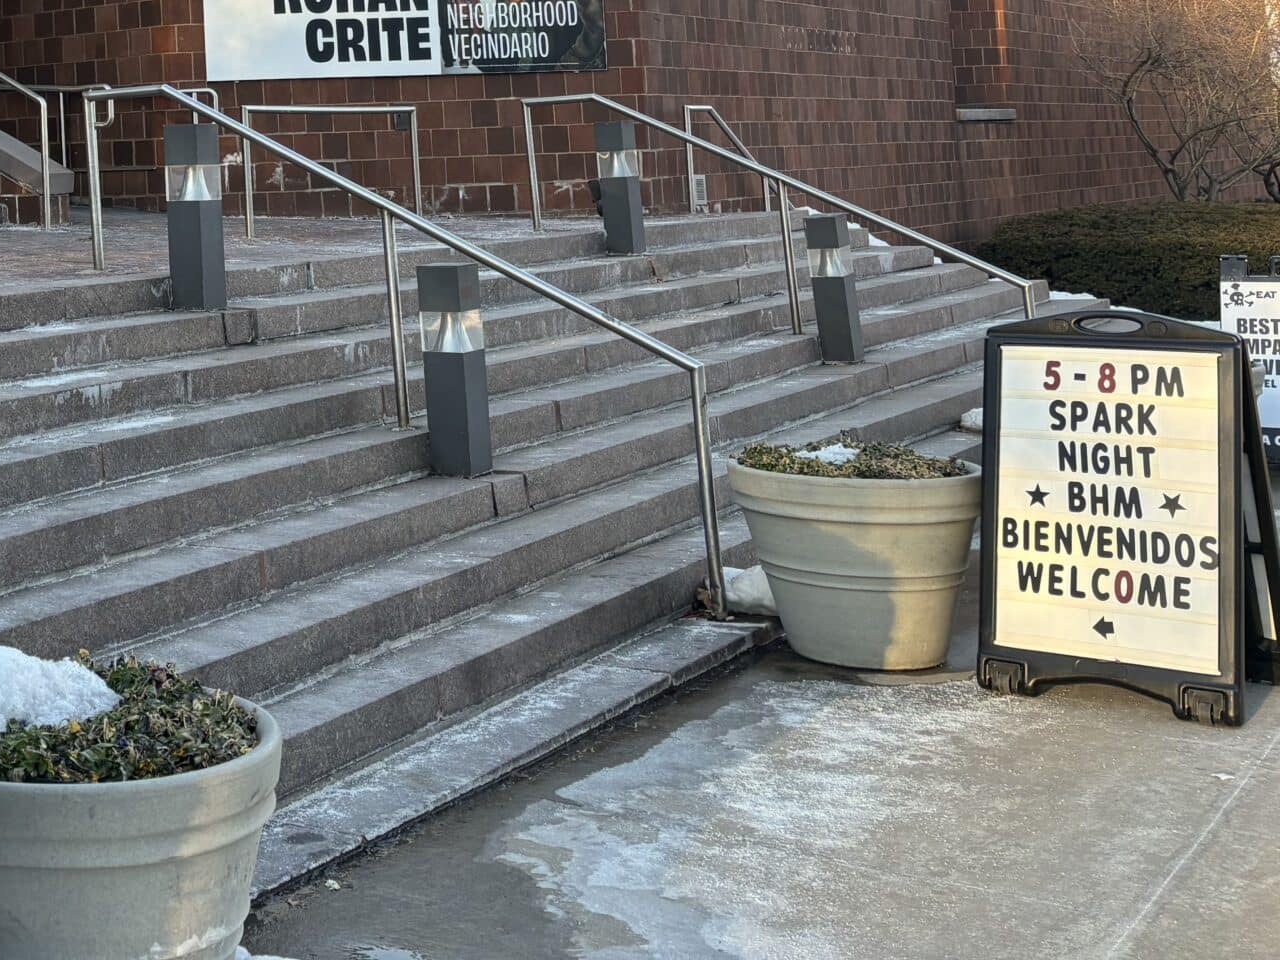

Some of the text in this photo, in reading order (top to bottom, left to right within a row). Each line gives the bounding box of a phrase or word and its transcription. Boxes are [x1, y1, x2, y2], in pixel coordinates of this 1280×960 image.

[446, 0, 579, 29] NEIGHBORHOOD
[305, 16, 433, 63] CRITE
[448, 31, 550, 60] VECINDARIO
[1255, 290, 1278, 299] EAT
[1236, 317, 1280, 335] BEST
[1130, 363, 1185, 397] PM
[1048, 399, 1157, 436] SPARK
[1057, 440, 1156, 478] NIGHT
[1067, 481, 1143, 519] BHM
[1001, 516, 1220, 571] BIENVENIDOS
[1016, 560, 1192, 610] WELCOME
